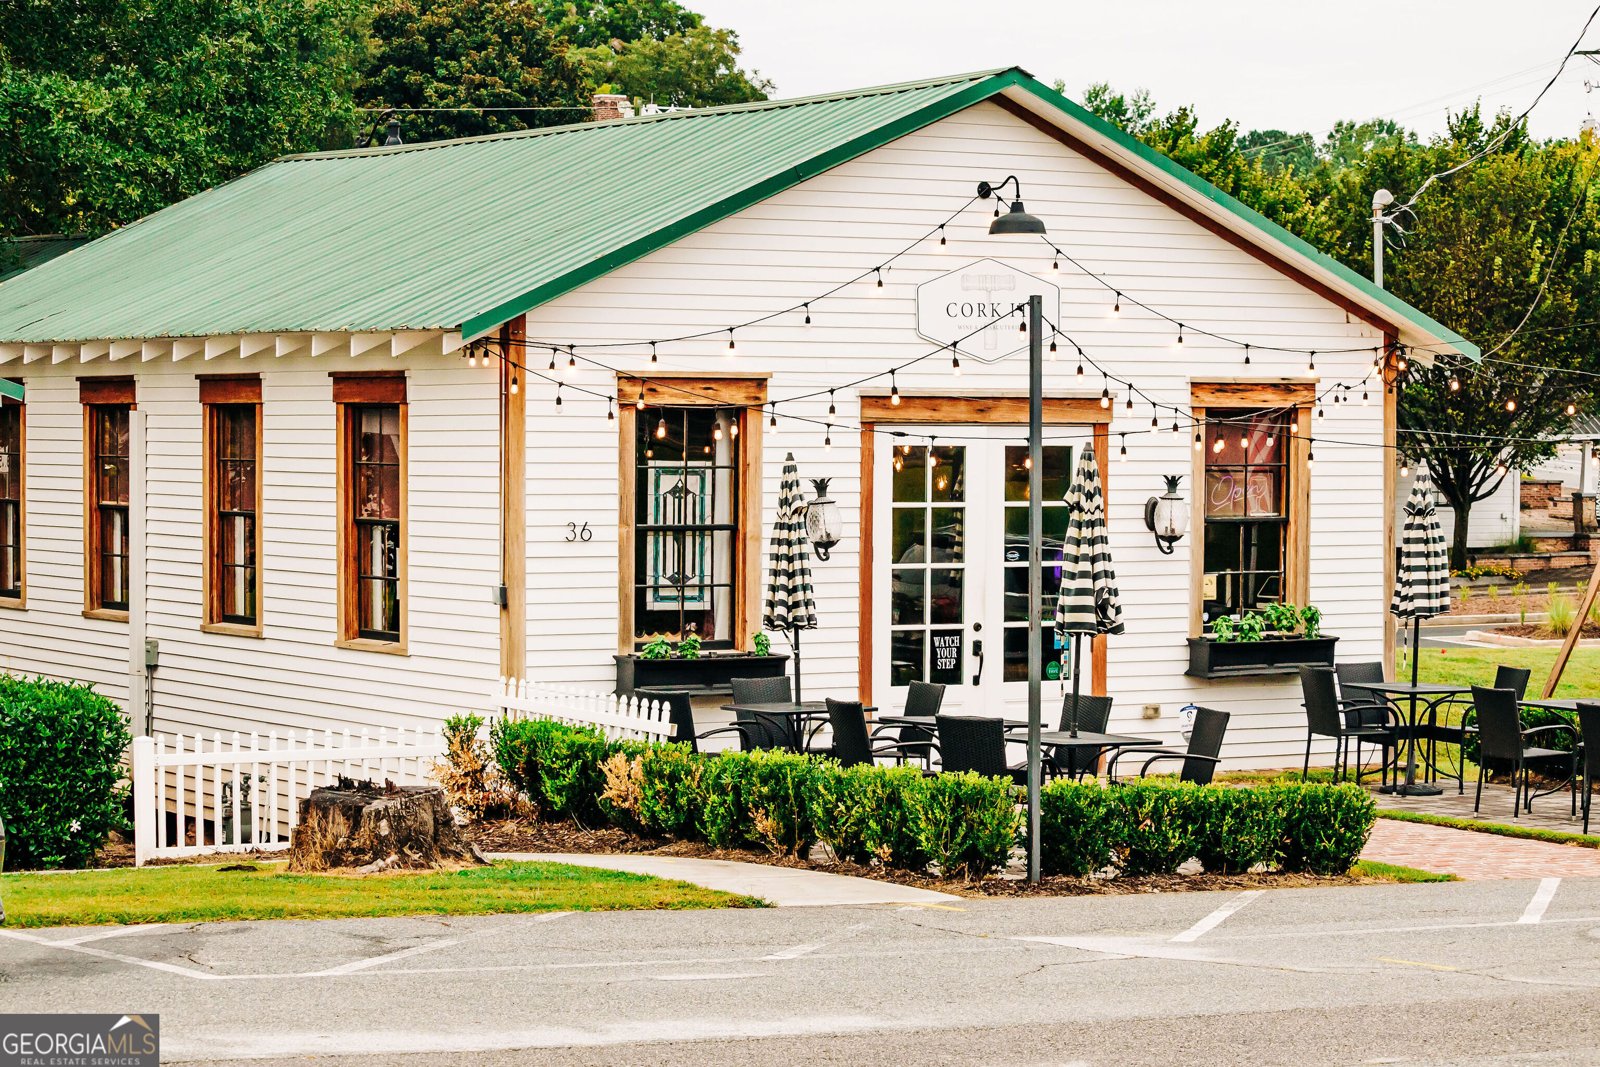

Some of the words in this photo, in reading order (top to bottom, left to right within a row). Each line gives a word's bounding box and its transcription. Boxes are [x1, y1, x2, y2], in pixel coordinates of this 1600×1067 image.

[946, 302, 1002, 318] CORK
[565, 521, 593, 542] 36
[933, 636, 960, 647] WATCH
[936, 647, 957, 658] YOUR
[937, 658, 956, 669] STEP
